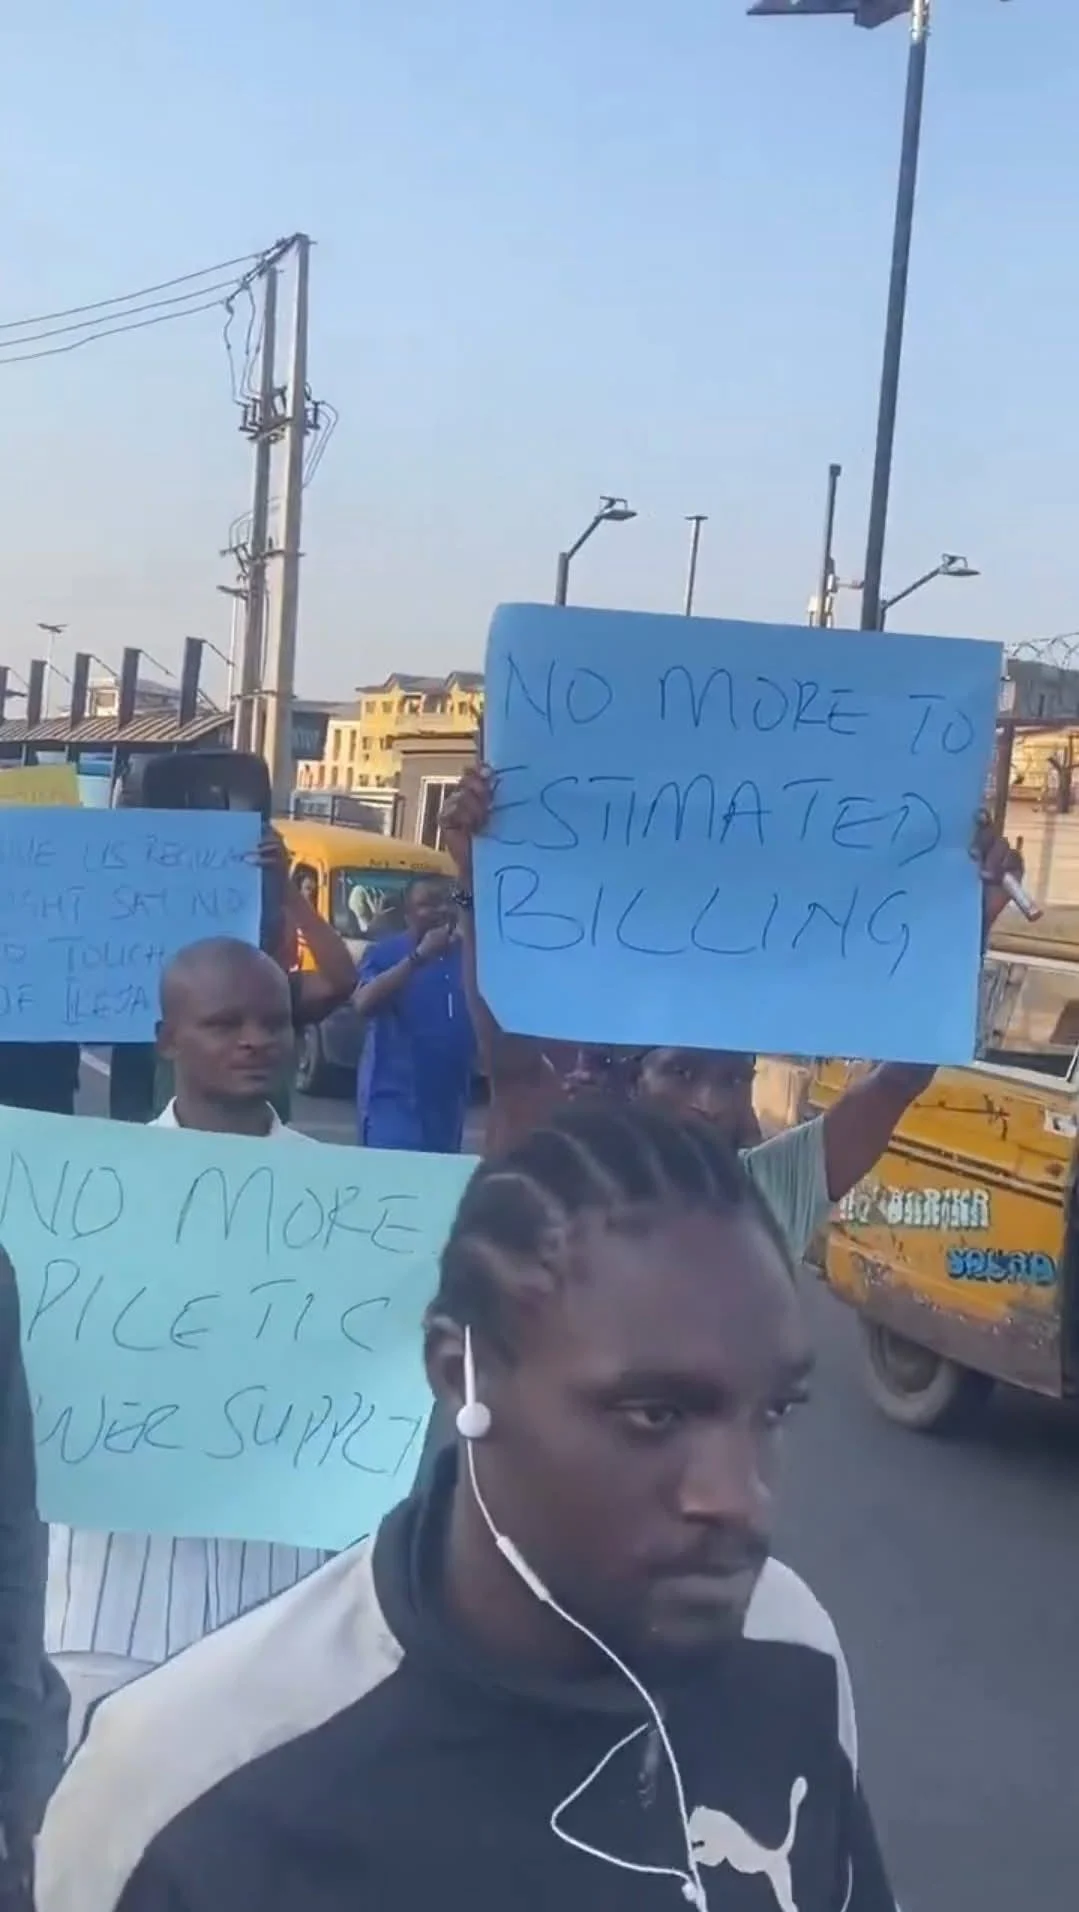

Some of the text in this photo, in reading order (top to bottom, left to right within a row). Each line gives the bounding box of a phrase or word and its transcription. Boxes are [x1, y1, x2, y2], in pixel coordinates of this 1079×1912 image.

[506, 655, 975, 756] NO MORE TO
[487, 765, 942, 867] ESTIMATED
[191, 886, 246, 917] NO
[494, 864, 912, 977] BILLING
[0, 1151, 423, 1255] NO MORE
[205, 1384, 423, 1478] SUPPLY
